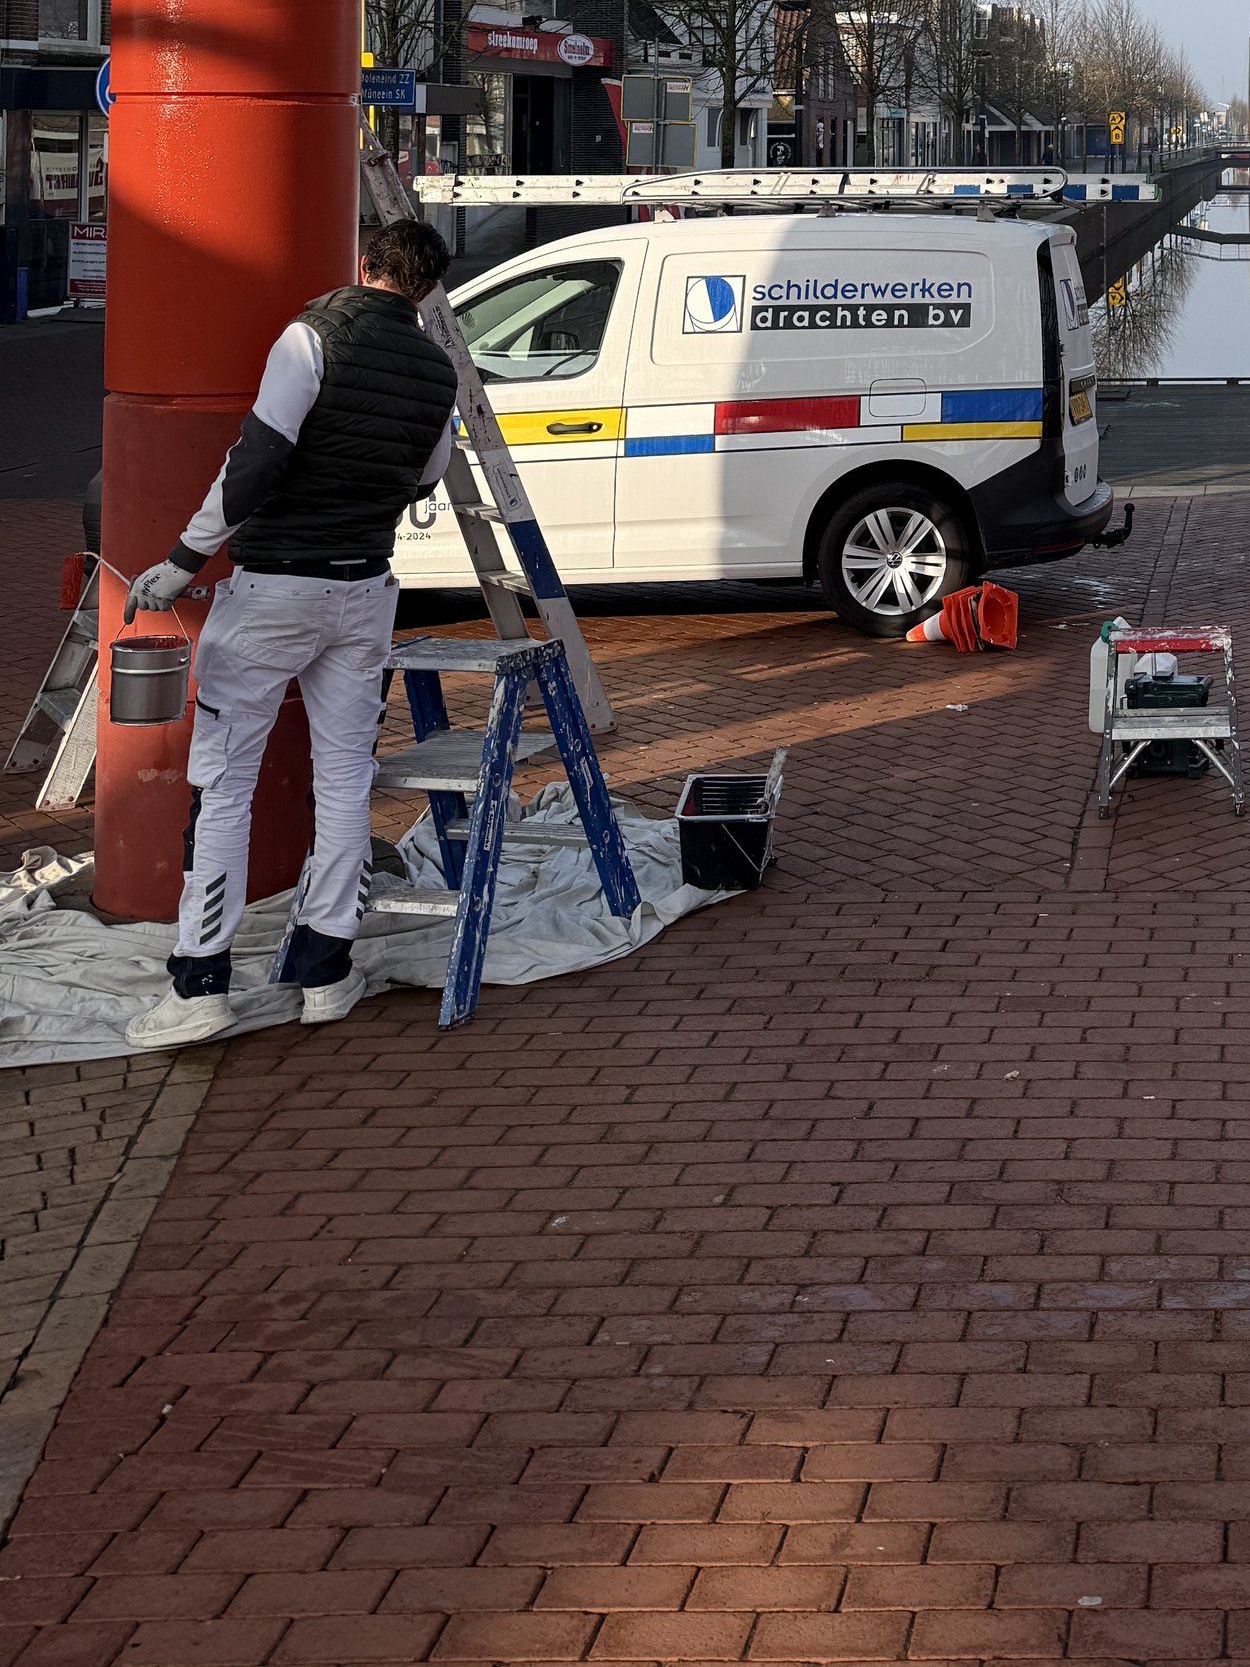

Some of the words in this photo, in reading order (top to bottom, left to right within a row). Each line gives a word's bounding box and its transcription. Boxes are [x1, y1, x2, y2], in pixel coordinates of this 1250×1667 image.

[487, 31, 539, 55] streekomroep
[399, 74, 411, 85] ZZ
[395, 88, 407, 100] SK
[73, 226, 107, 238] MIR
[752, 278, 973, 302] schilderwerken
[755, 305, 910, 328] drachten
[927, 305, 964, 326] bv
[396, 491, 437, 530] 0
